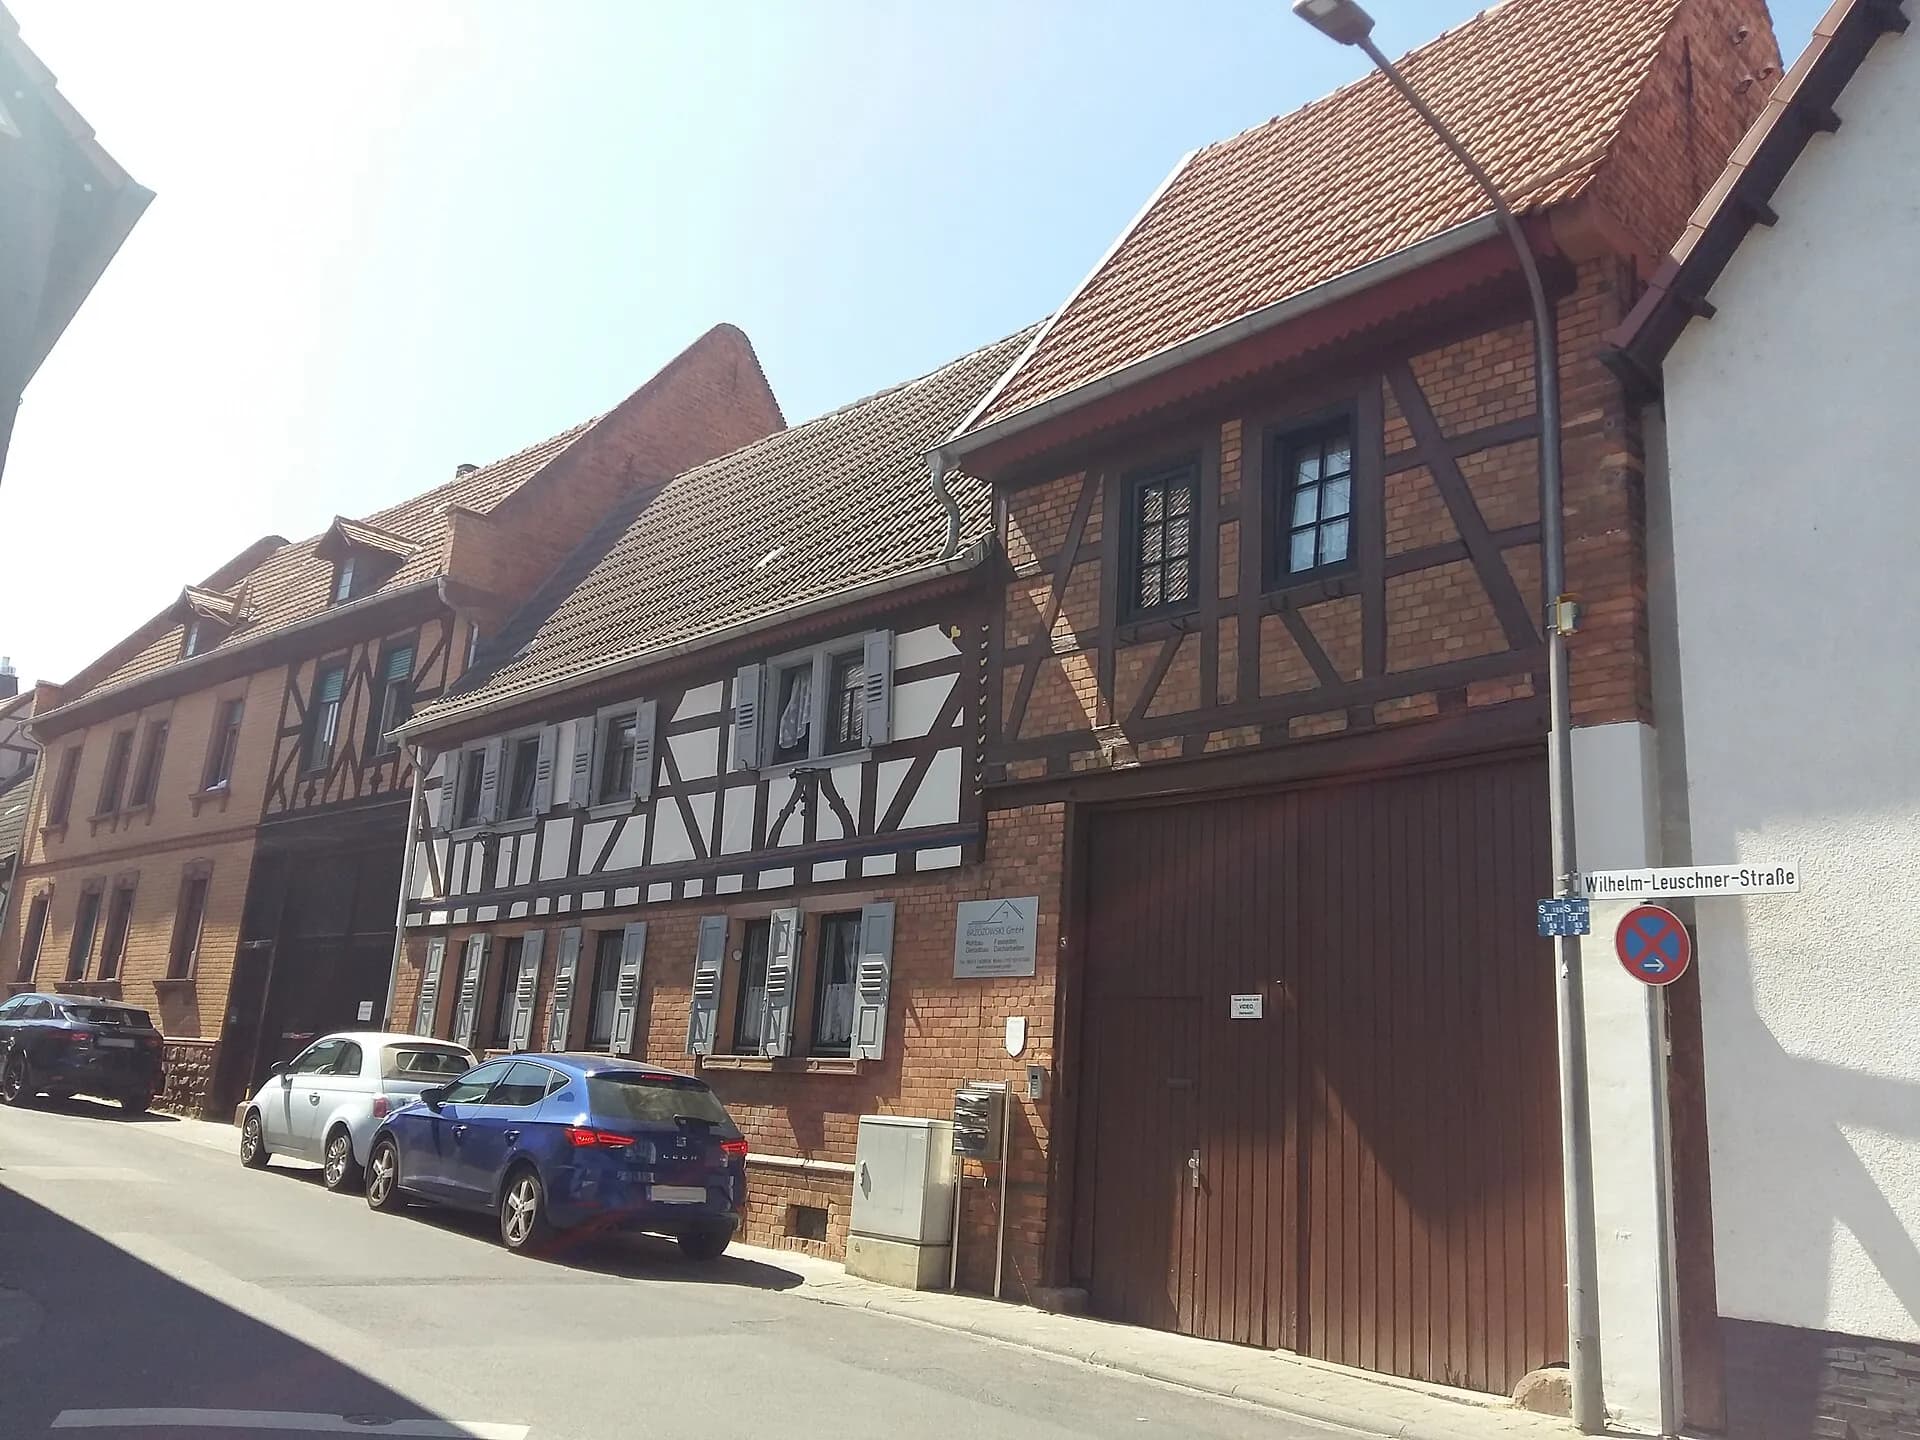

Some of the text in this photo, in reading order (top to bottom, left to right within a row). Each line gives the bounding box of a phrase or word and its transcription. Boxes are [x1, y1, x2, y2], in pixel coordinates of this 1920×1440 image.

[1585, 867, 1795, 893] Wilhelm-Leuschner-Straße
[1538, 905, 1546, 914] S
[1564, 904, 1572, 913] S
